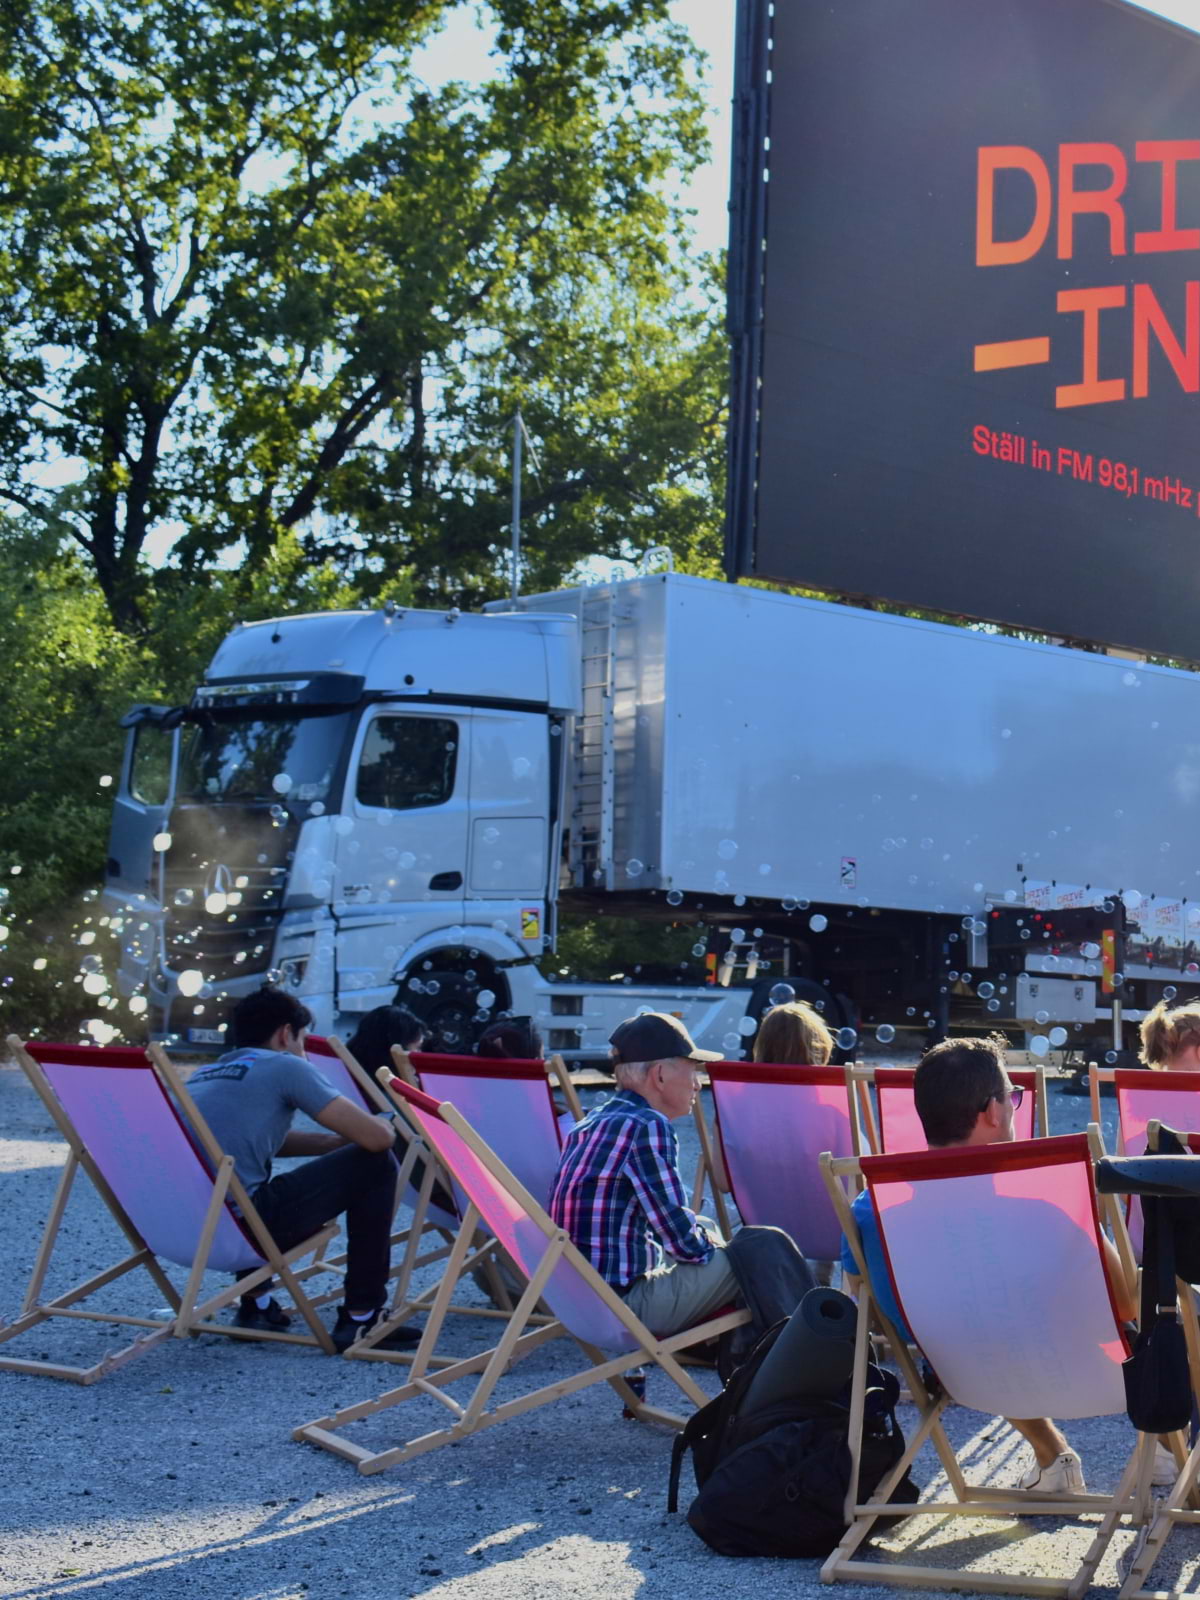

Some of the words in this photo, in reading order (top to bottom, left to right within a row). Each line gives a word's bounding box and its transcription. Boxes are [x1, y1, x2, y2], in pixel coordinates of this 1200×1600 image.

[973, 425, 1025, 464] Ställ
[1032, 440, 1051, 472] in
[1058, 448, 1093, 483] FM
[1099, 458, 1139, 499] 98,1
[1144, 476, 1192, 508] mHz
